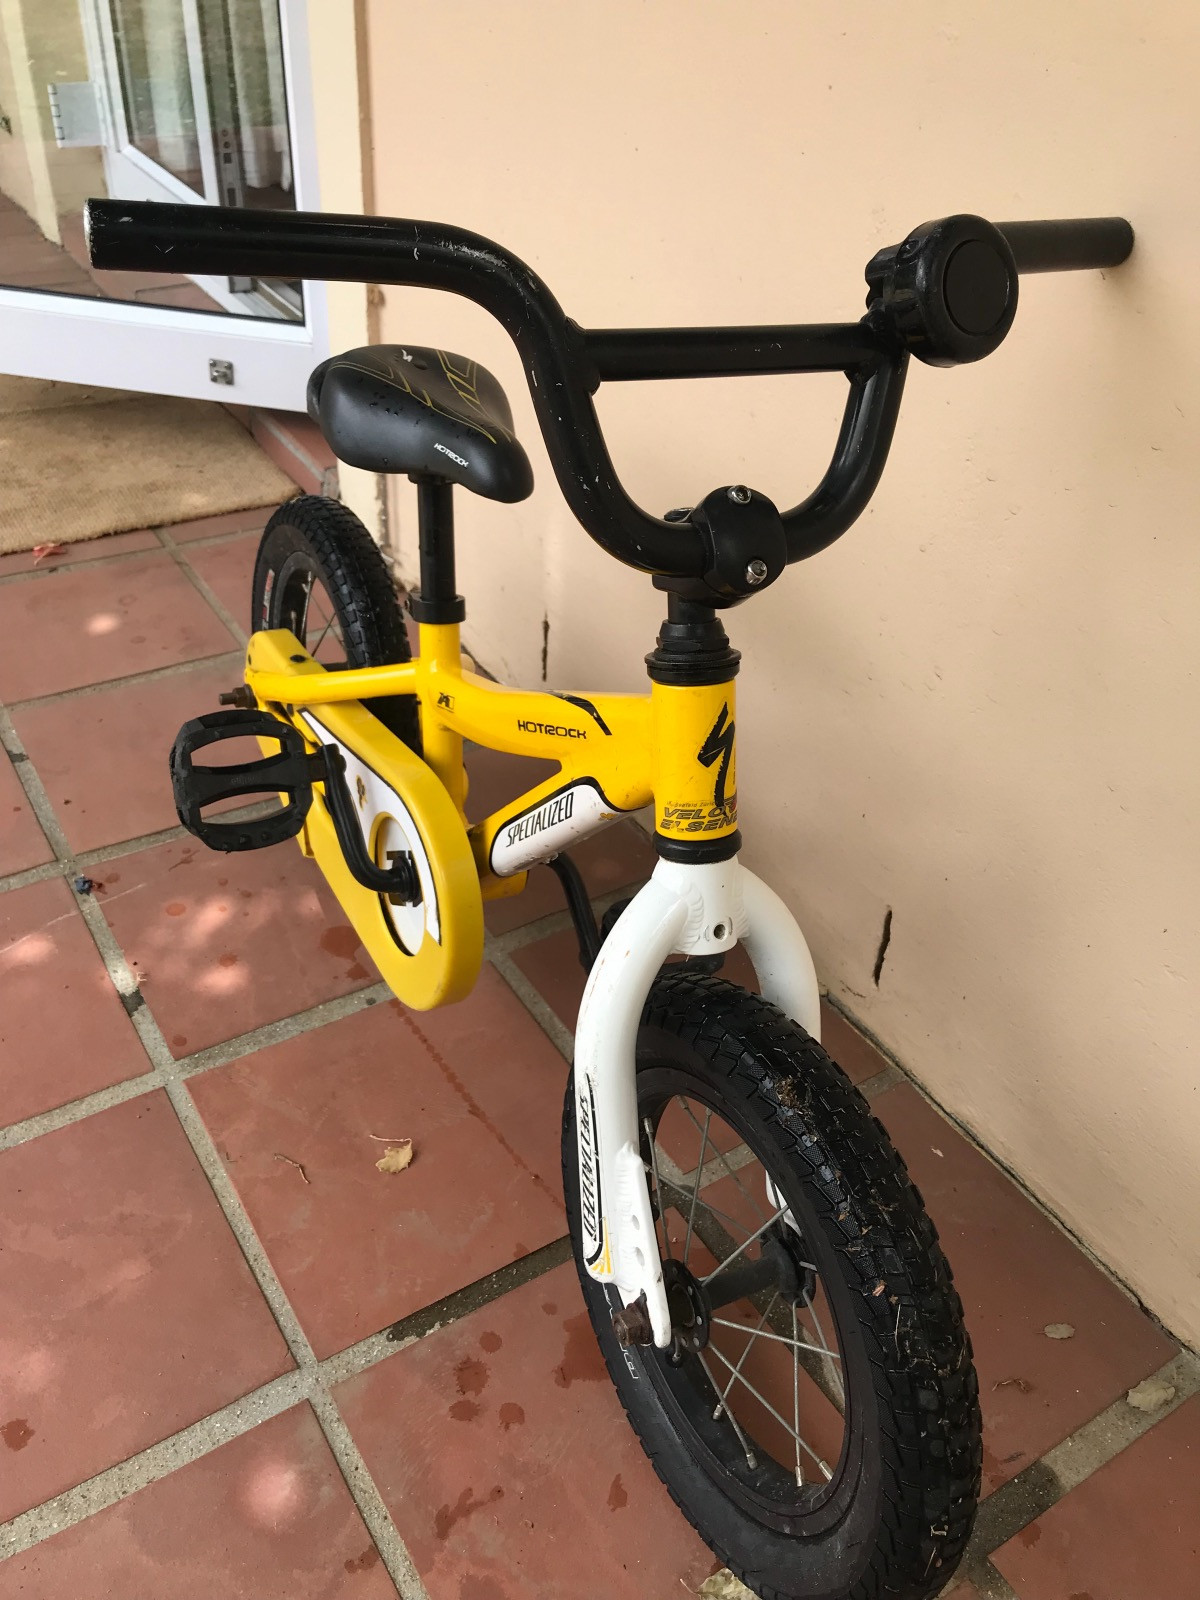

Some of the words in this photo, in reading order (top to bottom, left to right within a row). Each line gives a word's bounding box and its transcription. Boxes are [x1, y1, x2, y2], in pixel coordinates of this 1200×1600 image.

[434, 443, 468, 467] HOTROCK
[518, 720, 587, 739] HOTROCK
[506, 792, 574, 848] SPECIALIZED
